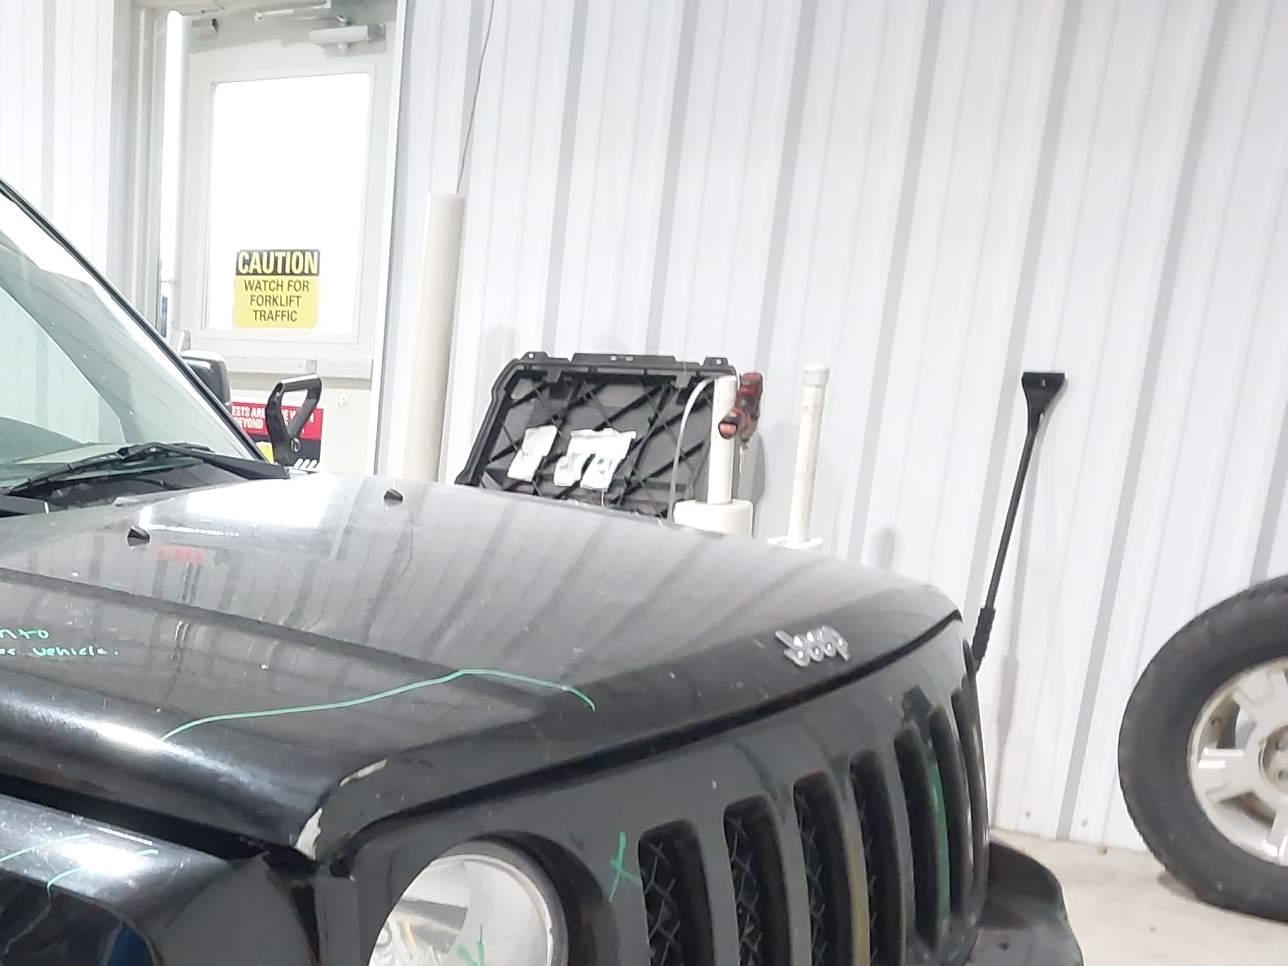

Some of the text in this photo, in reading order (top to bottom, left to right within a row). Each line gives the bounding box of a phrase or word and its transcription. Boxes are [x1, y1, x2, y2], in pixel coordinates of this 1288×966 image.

[238, 251, 318, 274] CAUTION
[244, 279, 310, 292] WATCH FOR
[250, 294, 302, 307] FORKLIFT
[253, 309, 298, 322] TRAFFIC
[775, 625, 849, 667] Jeep
